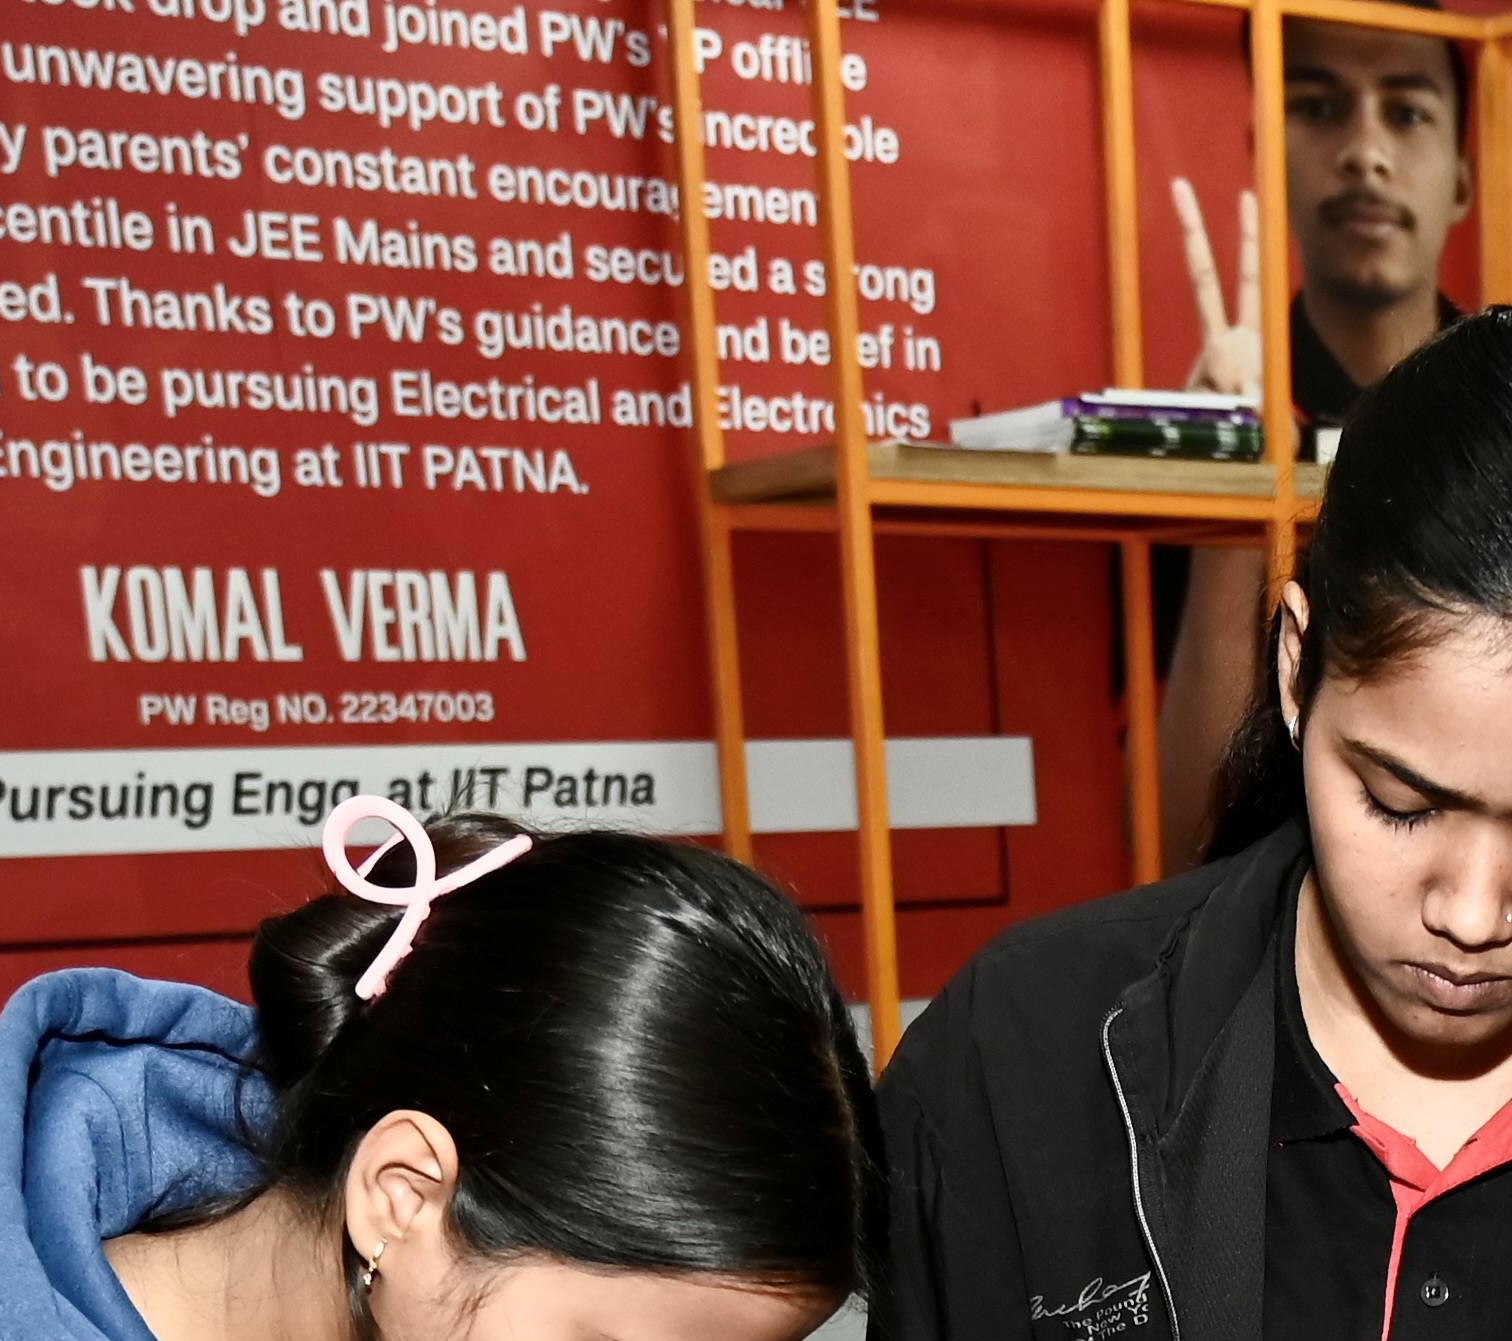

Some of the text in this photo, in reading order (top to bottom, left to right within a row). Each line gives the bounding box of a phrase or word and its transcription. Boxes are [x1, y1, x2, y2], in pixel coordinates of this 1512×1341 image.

[278, 0, 867, 91] and joined PW's offlie
[1, 42, 305, 120] unwavering
[317, 72, 505, 131] support
[514, 83, 561, 132] of
[264, 144, 477, 199] constant
[166, 202, 214, 254] in
[228, 210, 323, 262] JEE
[333, 217, 478, 272] Mains
[488, 232, 573, 279] and
[584, 245, 758, 291] secued
[768, 258, 796, 294] a
[803, 260, 935, 314] song
[82, 277, 273, 334] Thanks
[283, 292, 335, 337] to
[346, 293, 464, 345] PW's
[474, 303, 679, 358] guidance
[715, 316, 770, 362] nd
[779, 318, 894, 368] beef
[903, 326, 941, 371] in
[12, 354, 68, 401] to
[81, 353, 147, 405] be
[161, 364, 378, 426] pursuing
[391, 370, 600, 424] Electrical
[612, 384, 692, 427] and
[294, 444, 343, 487] at
[354, 443, 410, 488] IIT
[422, 445, 589, 494] PATNA.
[80, 565, 526, 661] KOMAL VERMA
[140, 692, 494, 731] PW Reg NO. 22347003
[389, 770, 434, 811] at
[450, 767, 510, 812] IIT
[524, 766, 656, 808] Patna
